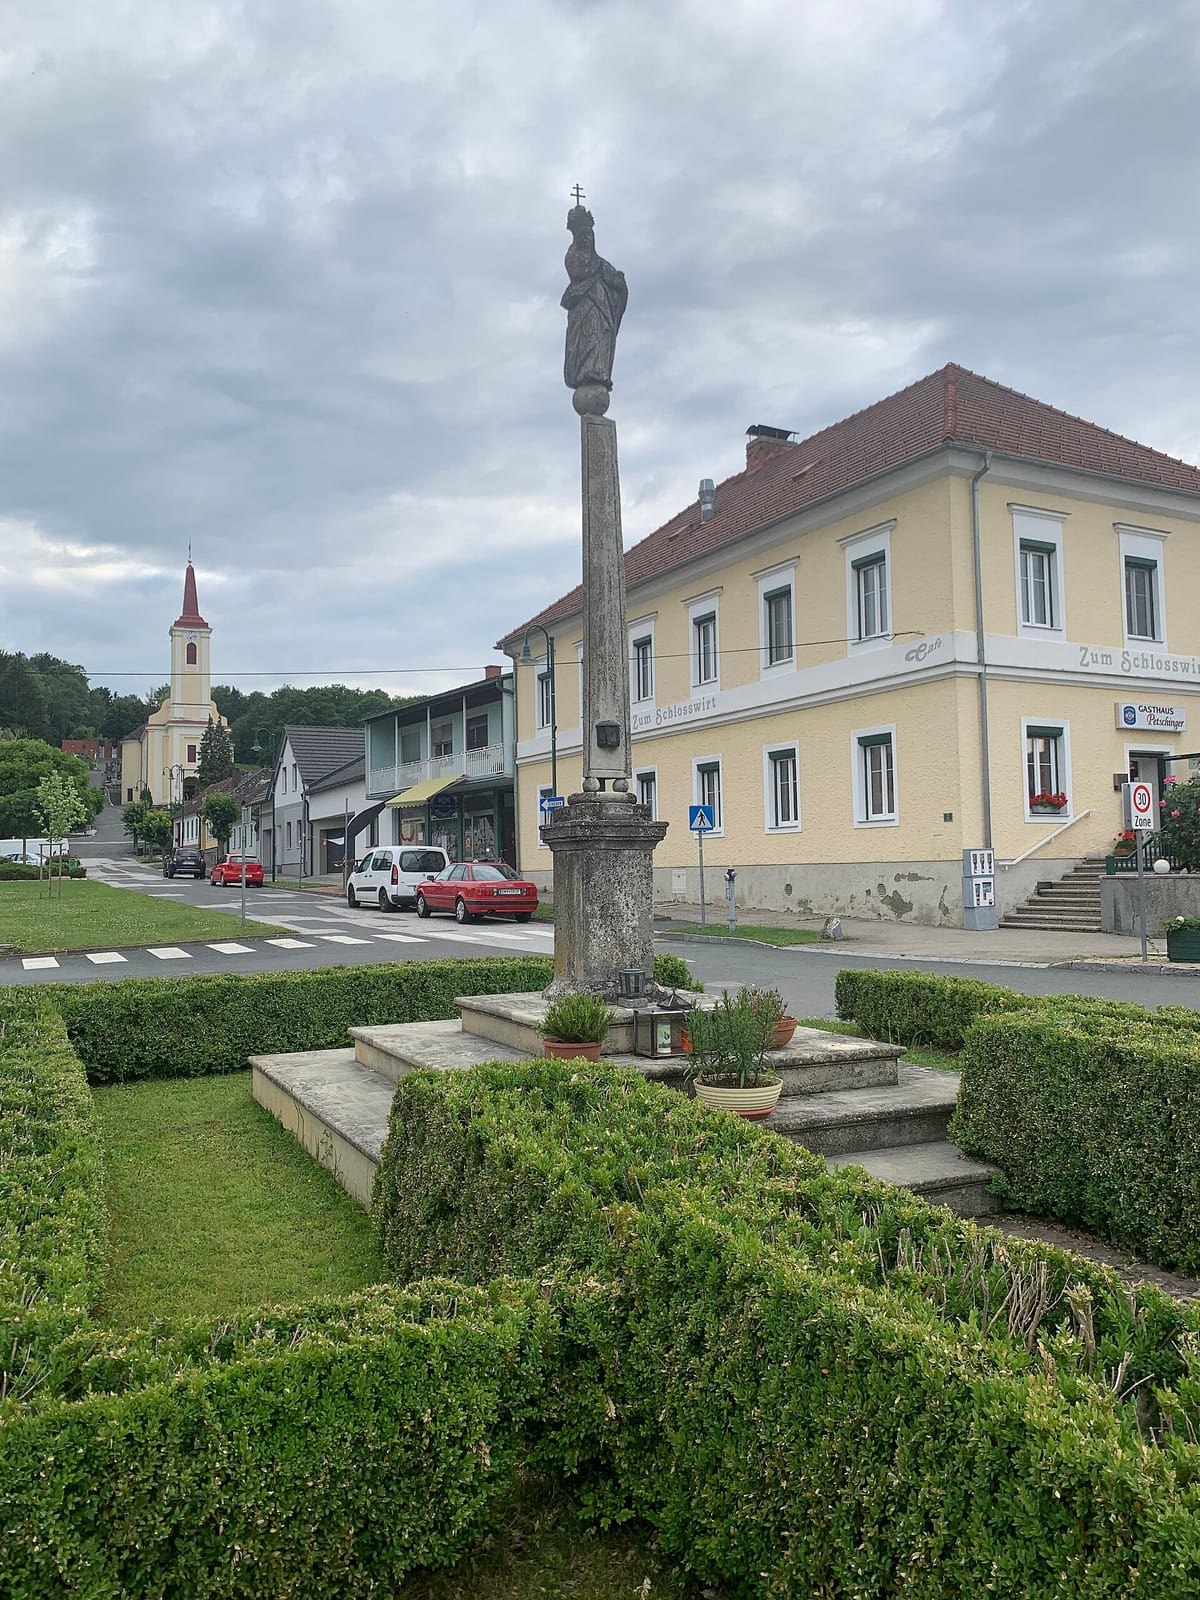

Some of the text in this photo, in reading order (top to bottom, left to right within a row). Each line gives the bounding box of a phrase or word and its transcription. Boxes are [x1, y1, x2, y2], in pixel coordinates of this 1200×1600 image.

[1079, 646, 1113, 667] Zum
[632, 696, 716, 730] Zum Schlosswirt
[1138, 705, 1174, 715] GASTHAUS
[1146, 713, 1184, 730] Petschinger
[1137, 792, 1147, 806] 30
[1134, 815, 1152, 827] Zone
